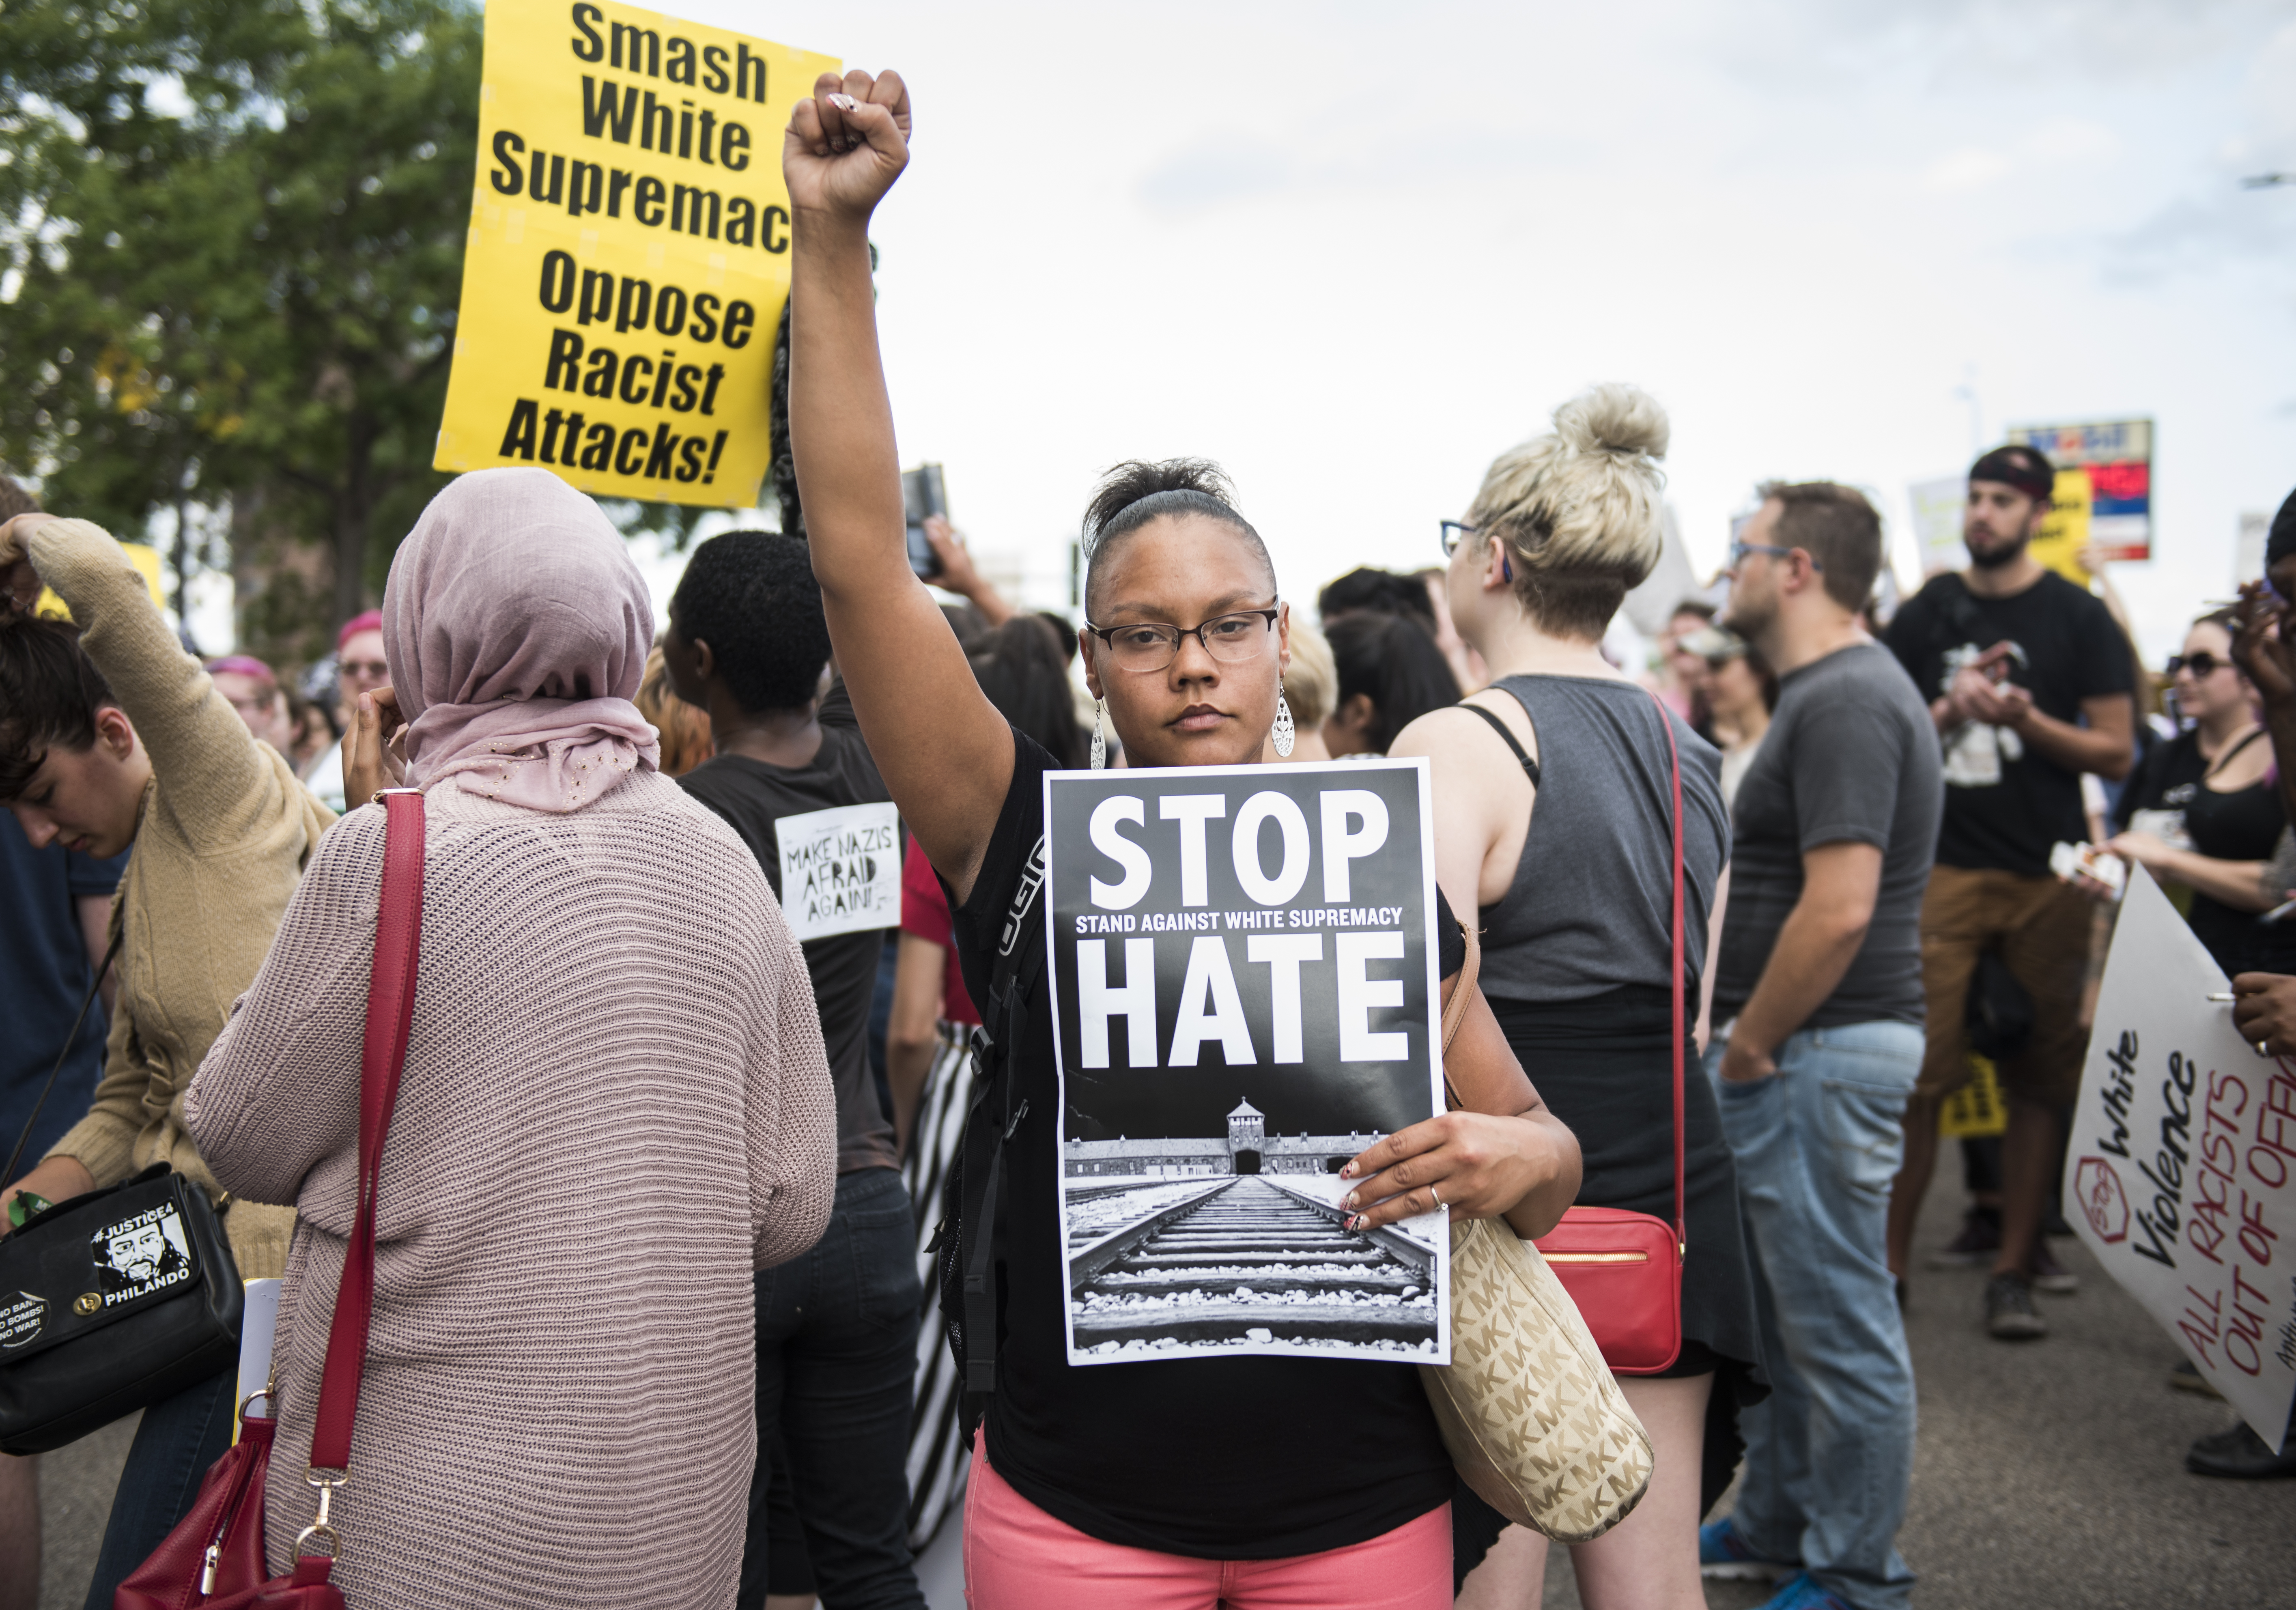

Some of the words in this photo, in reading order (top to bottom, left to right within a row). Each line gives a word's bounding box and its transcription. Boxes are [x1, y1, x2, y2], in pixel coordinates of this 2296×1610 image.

[572, 2, 767, 103] Smash
[582, 75, 751, 171] White
[491, 131, 790, 254] Supremac
[539, 249, 755, 350] Oppose
[544, 328, 725, 415] Racist
[499, 398, 729, 484] Attacks!
[787, 837, 832, 873] MAKE
[837, 826, 892, 857] NAZIS
[802, 855, 877, 902] AFRAID
[1089, 789, 1389, 911] STOP
[1076, 914, 1136, 934] STAND
[1141, 912, 1220, 932] AGAINST
[1224, 910, 1285, 929] WHITE
[1289, 907, 1403, 928] SUPREMACY
[1077, 930, 1409, 1068] HATE
[2097, 1029, 2138, 1158] White
[2132, 1050, 2196, 1269] Violence
[2186, 1070, 2249, 1266] RACISTS
[92, 1202, 174, 1243] #JUSTICE4
[2238, 1188, 2279, 1267] OF
[7, 1304, 44, 1326] BOMBS!
[14, 1317, 41, 1333] WAR!
[105, 1268, 189, 1307] PHILANDO
[2176, 1284, 2222, 1371] ALL
[2223, 1264, 2271, 1377] OUT
